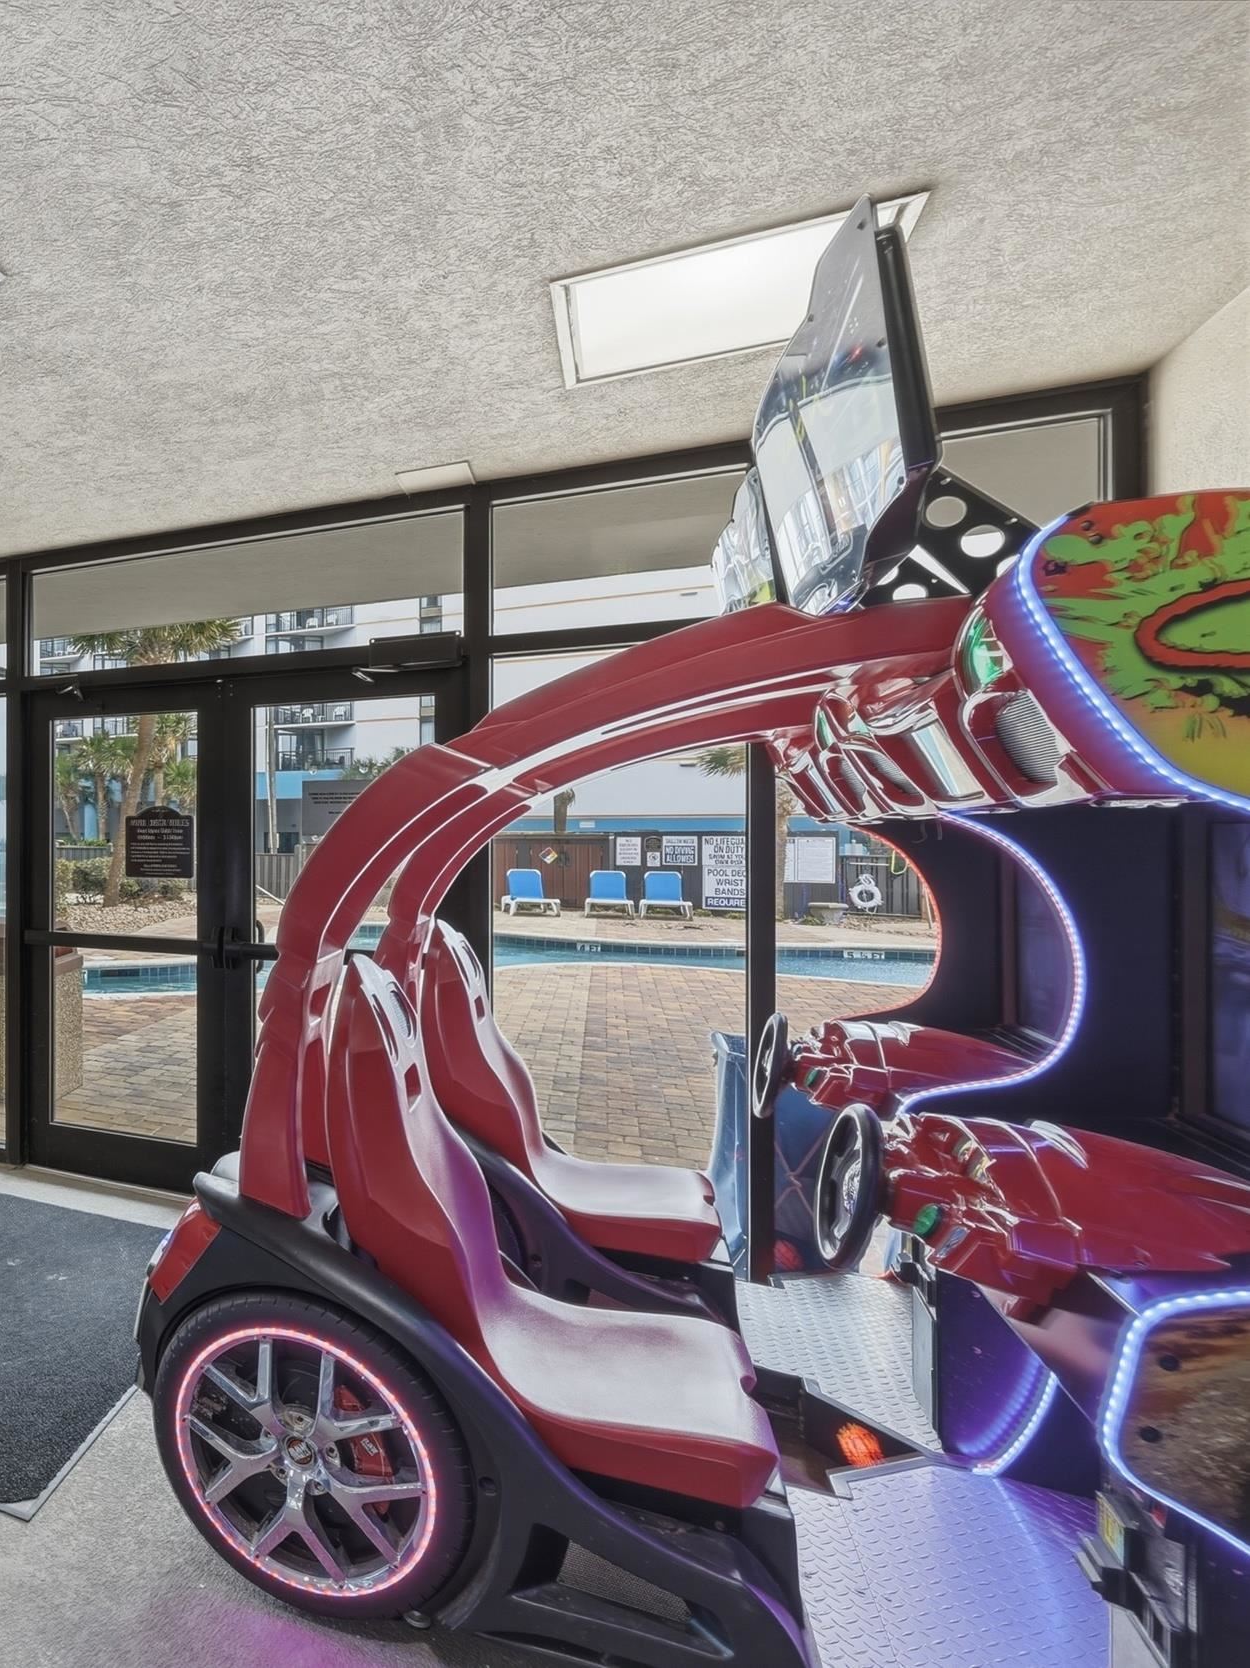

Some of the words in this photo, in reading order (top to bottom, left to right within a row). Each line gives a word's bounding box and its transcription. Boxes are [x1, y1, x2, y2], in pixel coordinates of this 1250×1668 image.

[704, 838, 714, 846] NO
[715, 838, 745, 846] LIFEGUA
[665, 846, 674, 854] NO
[713, 845, 724, 854] ON
[725, 845, 744, 854] DUTY
[707, 869, 729, 877] POOL
[731, 869, 746, 878] DEC
[715, 878, 744, 887] WRIST
[714, 888, 746, 896] BANDS
[707, 899, 746, 907] REQUIRE
